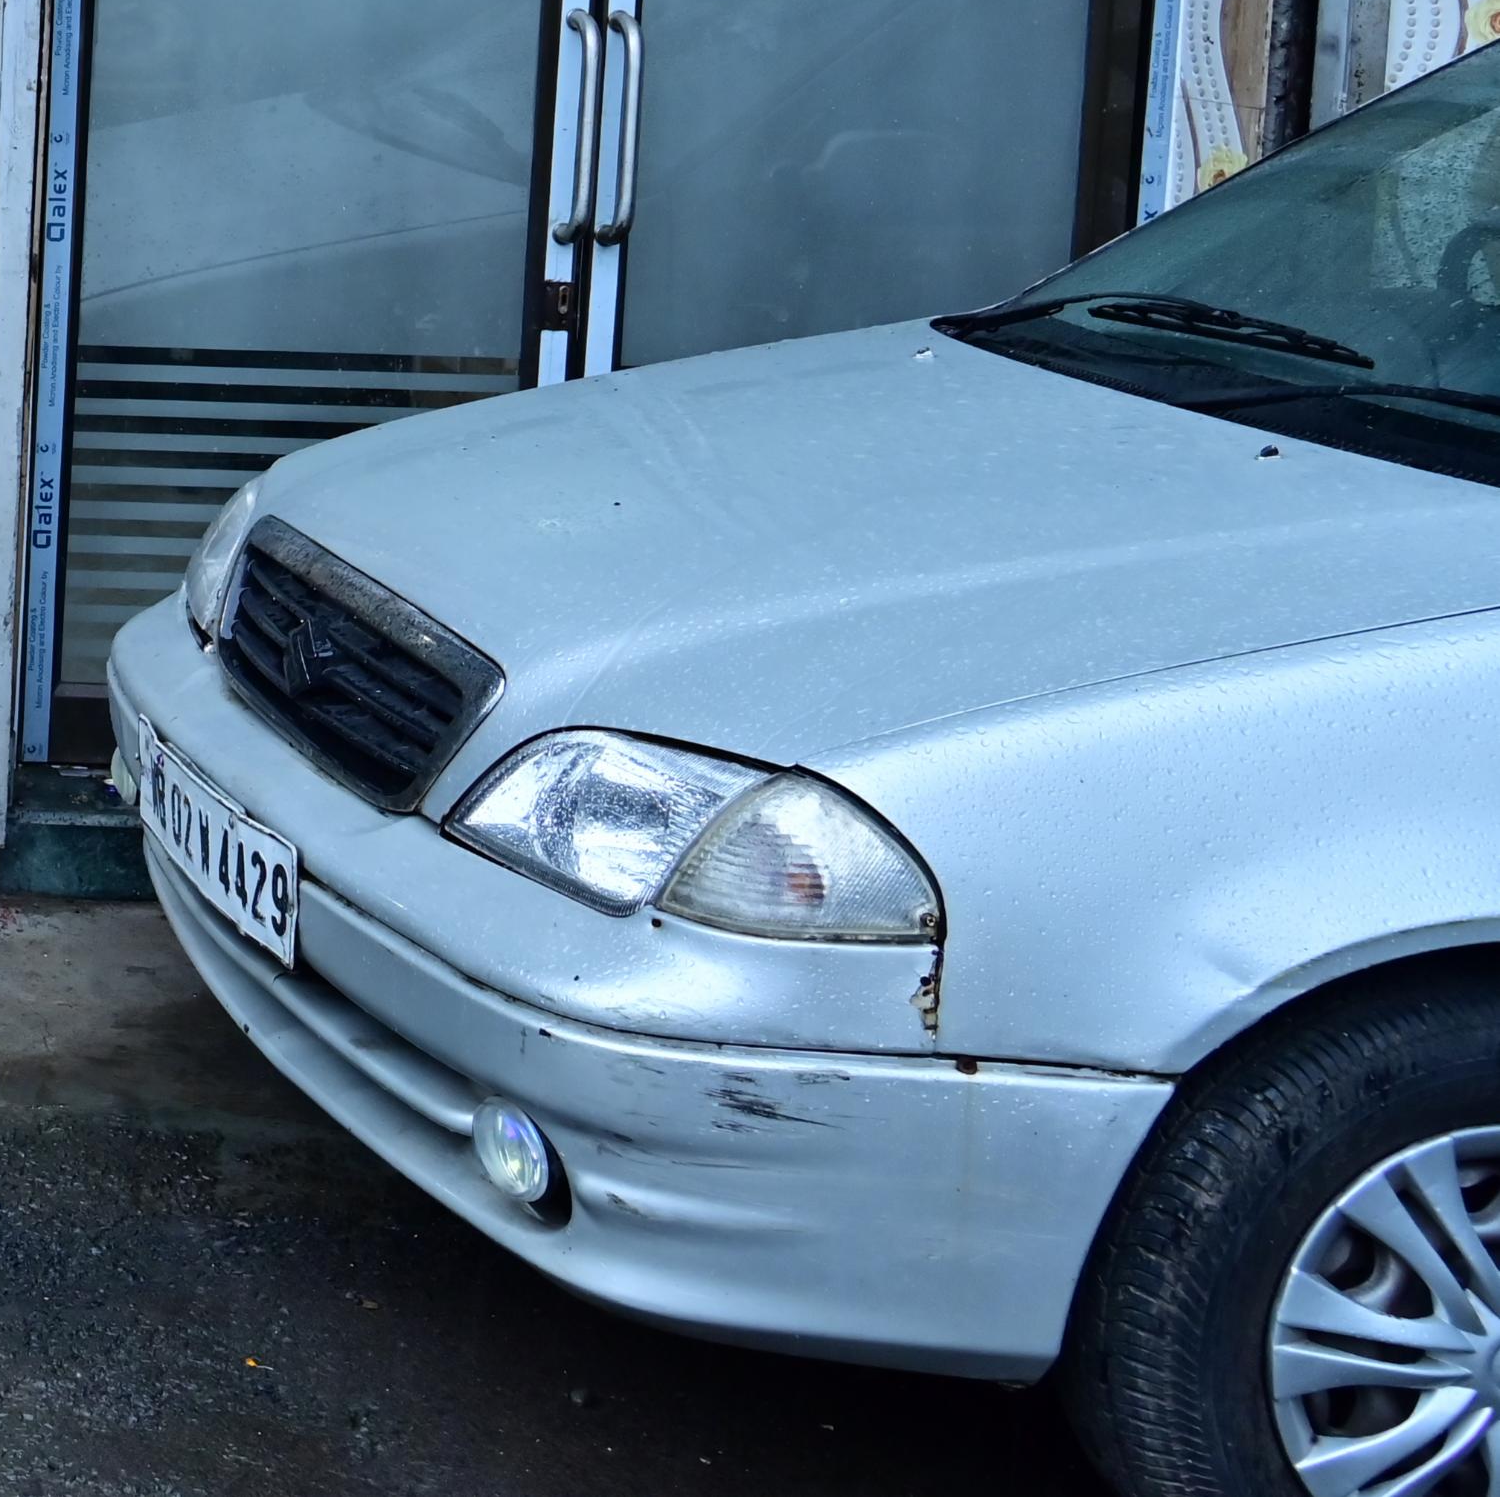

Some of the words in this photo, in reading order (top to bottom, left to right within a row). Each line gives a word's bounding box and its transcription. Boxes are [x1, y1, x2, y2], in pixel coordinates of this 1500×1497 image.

[64, 33, 73, 68] Anodising
[62, 70, 70, 95] Micron
[53, 275, 61, 299] Colour
[42, 311, 51, 339] Coating
[52, 302, 60, 328] Electro
[51, 330, 59, 343] and
[41, 341, 50, 369] Powder
[217, 825, 289, 938] 4429
